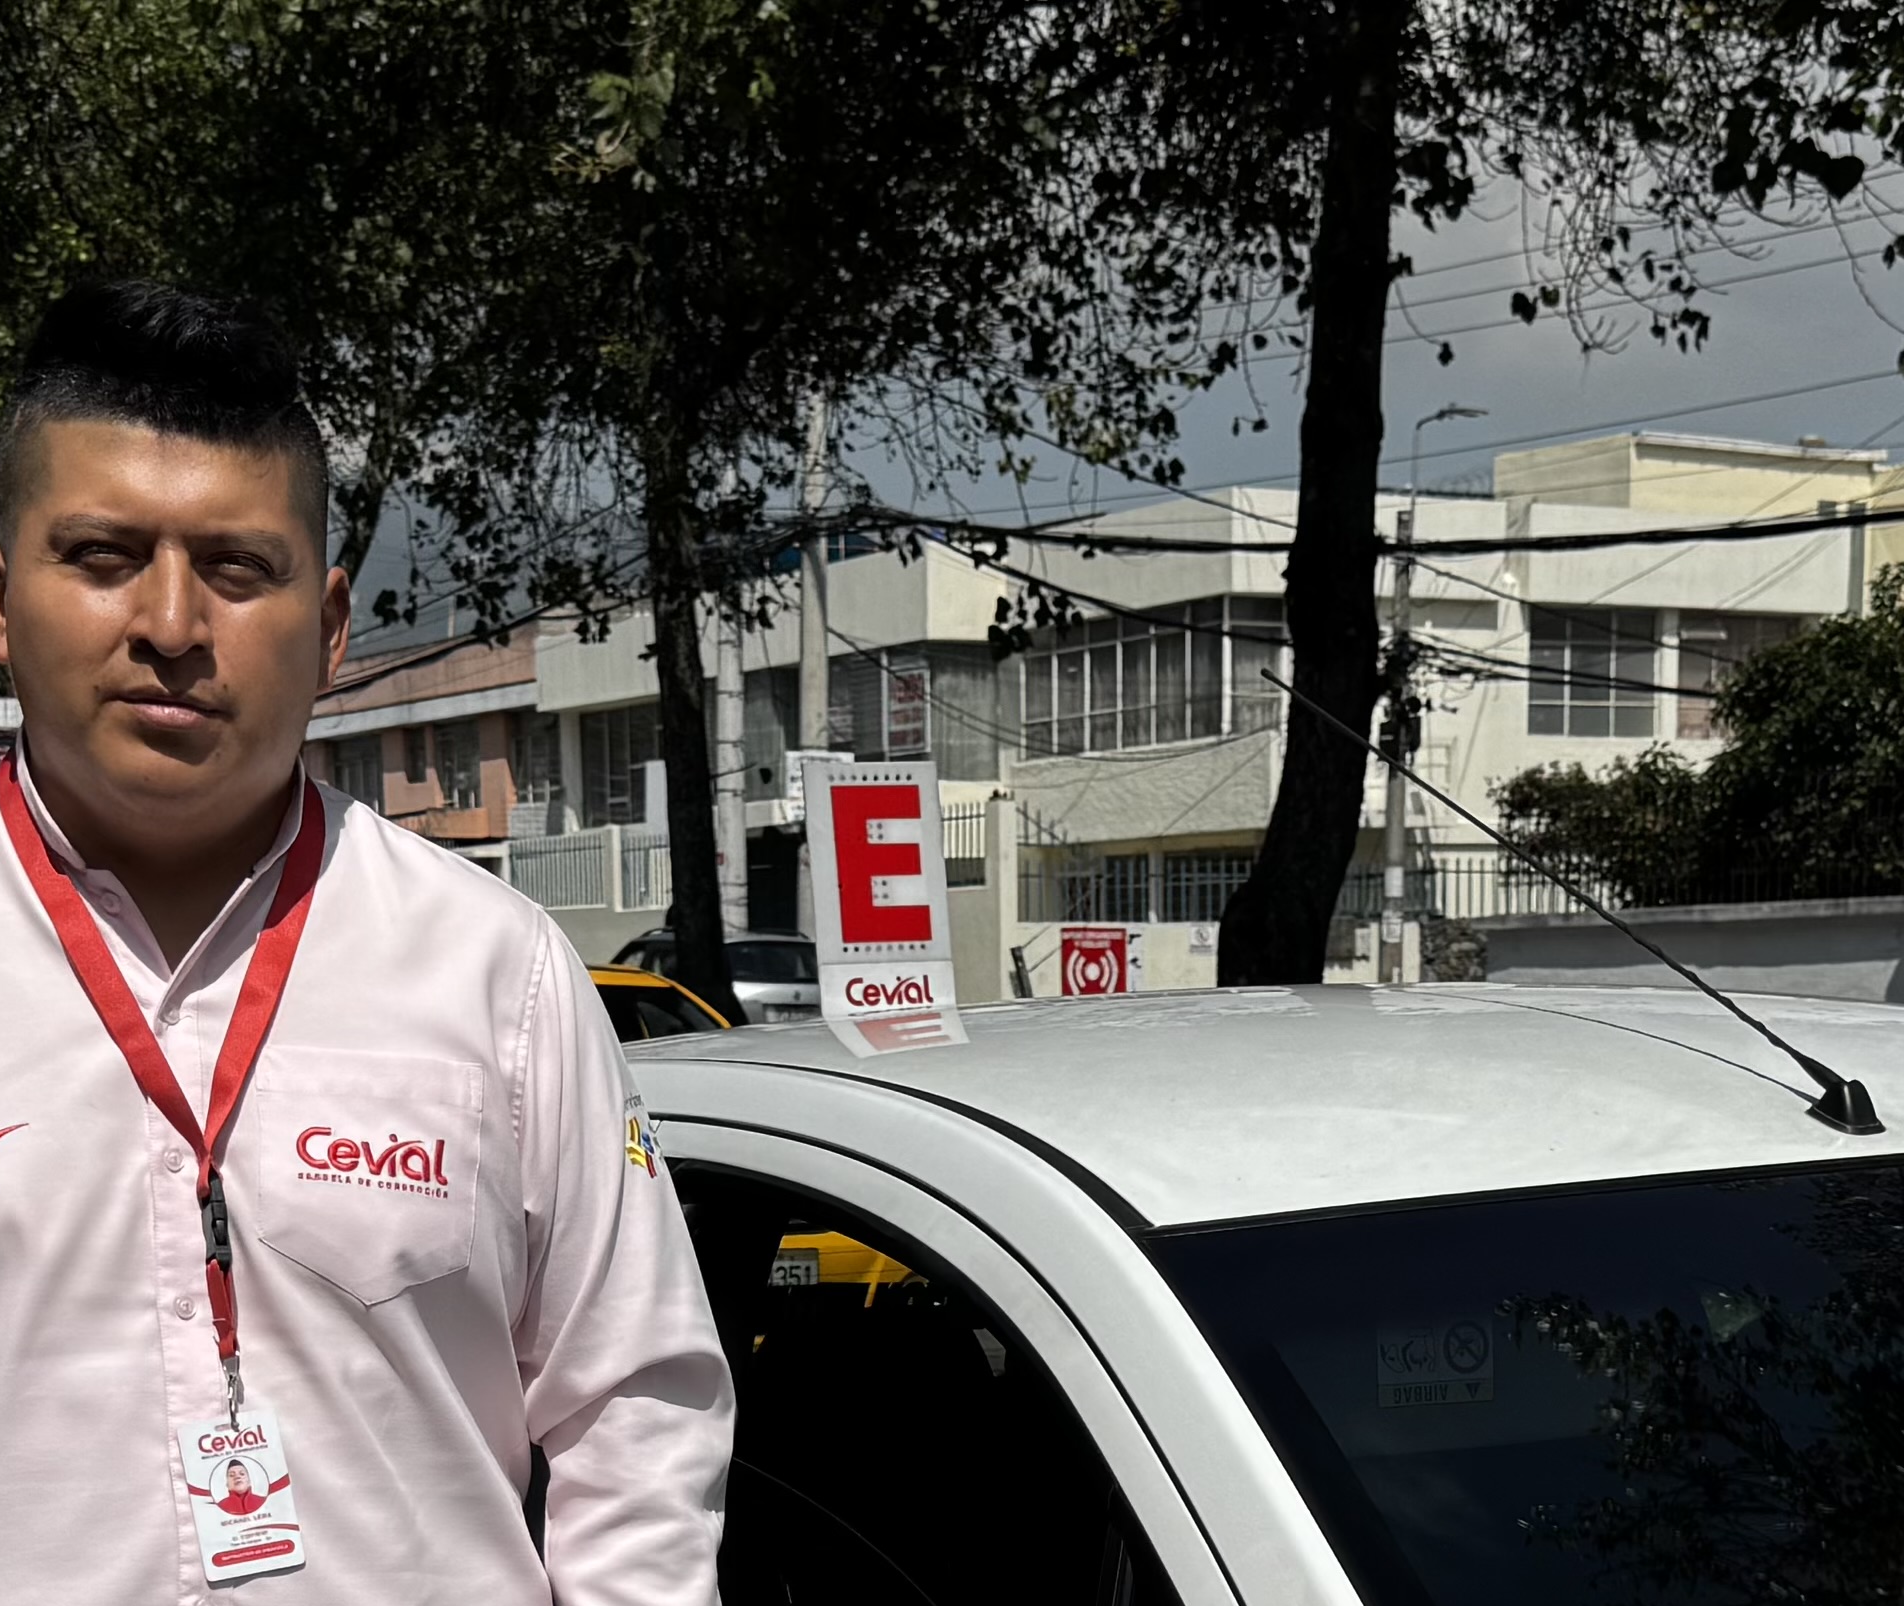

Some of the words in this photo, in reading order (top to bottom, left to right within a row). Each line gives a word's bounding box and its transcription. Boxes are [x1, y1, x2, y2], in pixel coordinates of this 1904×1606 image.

[829, 785, 933, 943] E
[845, 974, 934, 1007] Cevial
[296, 1126, 448, 1187] Cevial
[198, 1424, 268, 1454] Cevial
